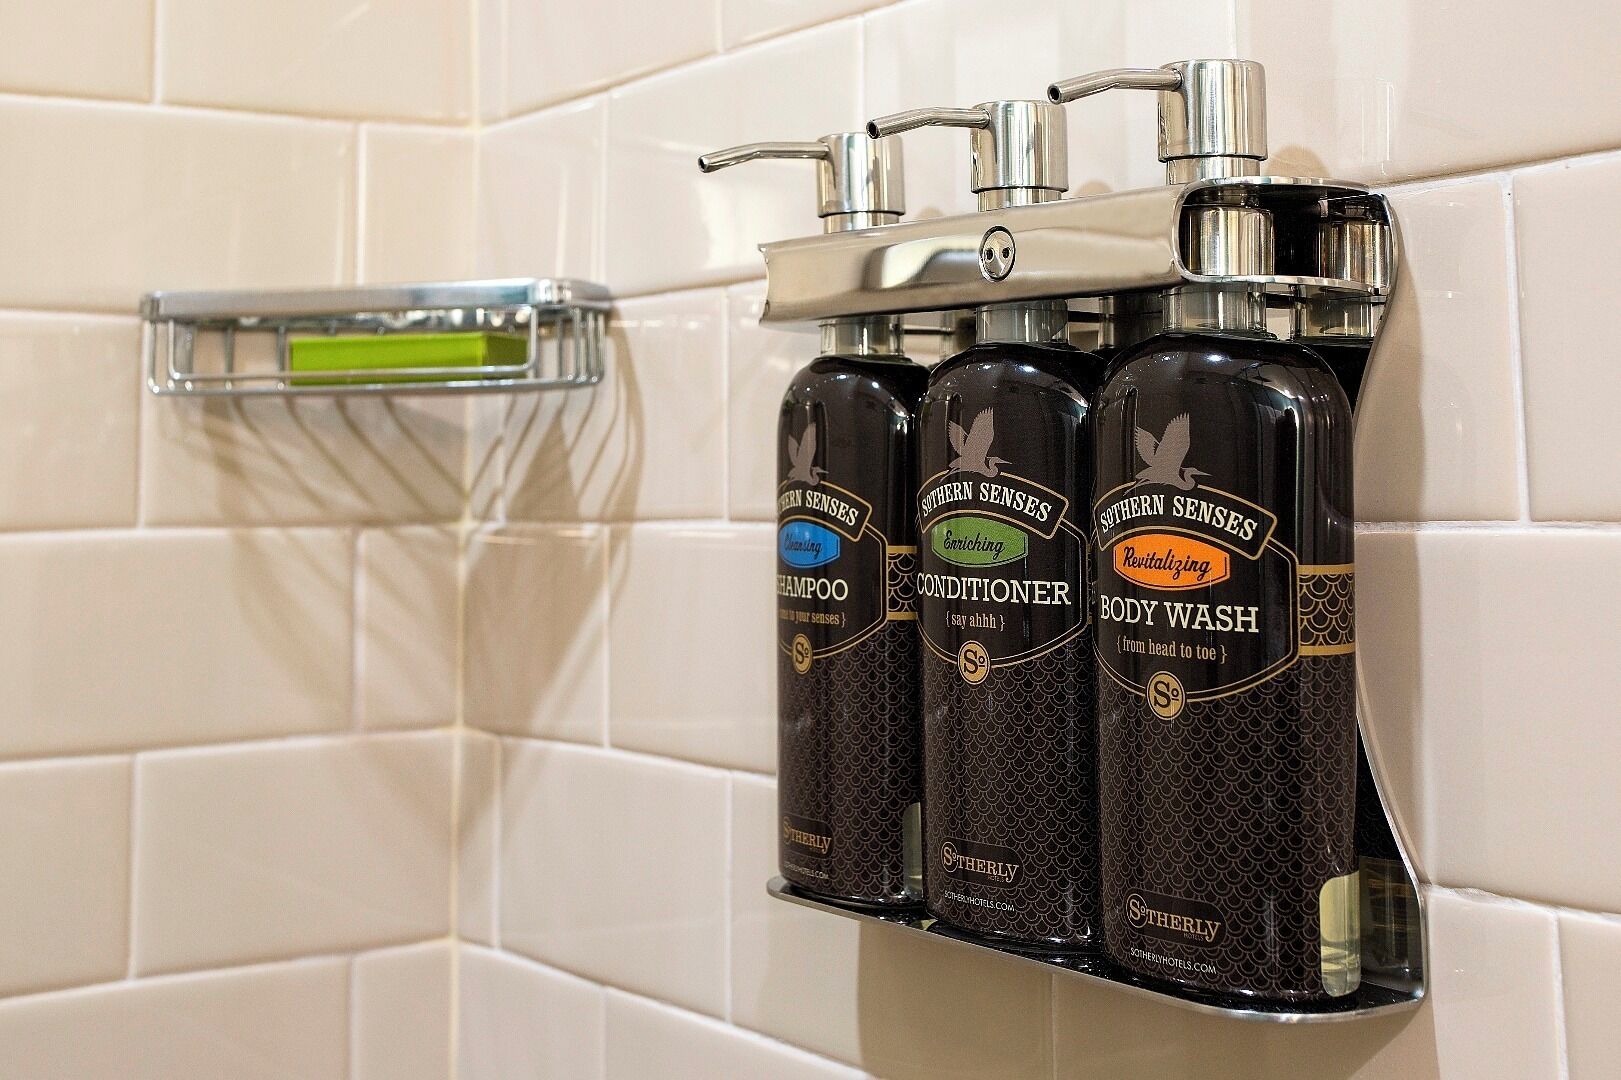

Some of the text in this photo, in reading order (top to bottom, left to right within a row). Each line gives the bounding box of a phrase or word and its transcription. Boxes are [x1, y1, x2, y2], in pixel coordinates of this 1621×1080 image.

[805, 490, 859, 526] SENSES
[979, 482, 1052, 523] SENSES
[1172, 495, 1258, 541] SENSES
[943, 529, 1006, 560] Enriching
[1122, 546, 1213, 582] Revitalizing
[916, 572, 1072, 606] CONDITIONER
[811, 612, 840, 625] senses
[951, 613, 967, 630] say
[969, 613, 997, 629] ahhh
[1100, 594, 1260, 633] BODY WASH
[1122, 634, 1146, 654] from
[1148, 638, 1177, 657] head
[1180, 642, 1193, 659] to
[1196, 644, 1217, 661] toe
[944, 889, 1015, 912] SOTHERLYHOTELS.COM
[1130, 947, 1217, 975] SOTHERLYHOTELS.COM
